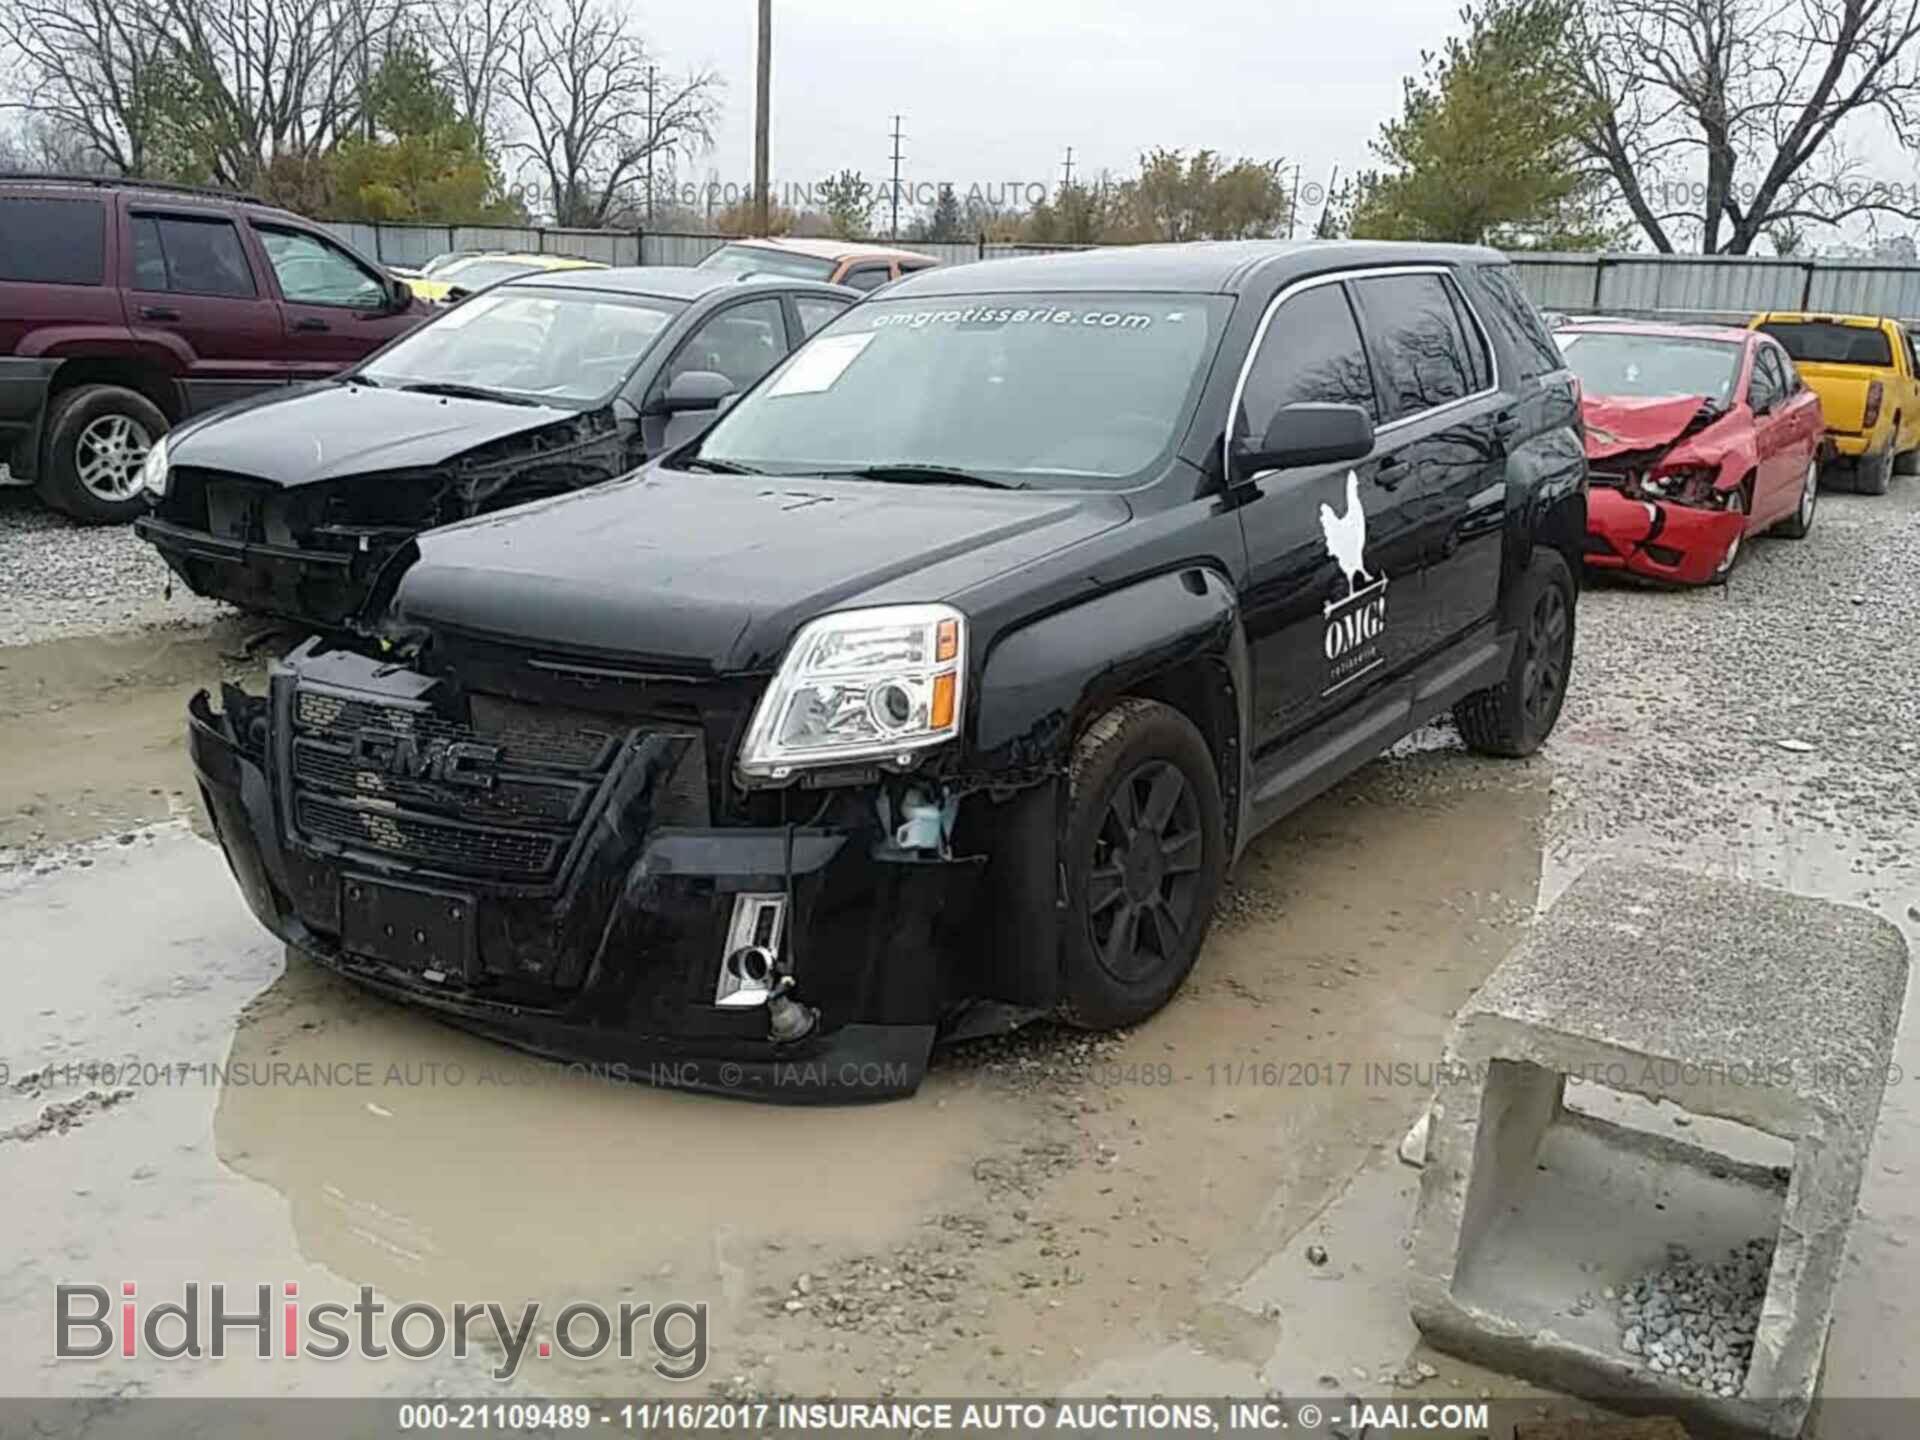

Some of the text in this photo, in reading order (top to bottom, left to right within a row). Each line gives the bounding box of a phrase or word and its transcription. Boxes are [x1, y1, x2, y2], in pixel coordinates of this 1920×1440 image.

[871, 305, 1151, 329] omgrotisserie.com
[1325, 597, 1385, 659] OMG!
[353, 726, 500, 789] GMC
